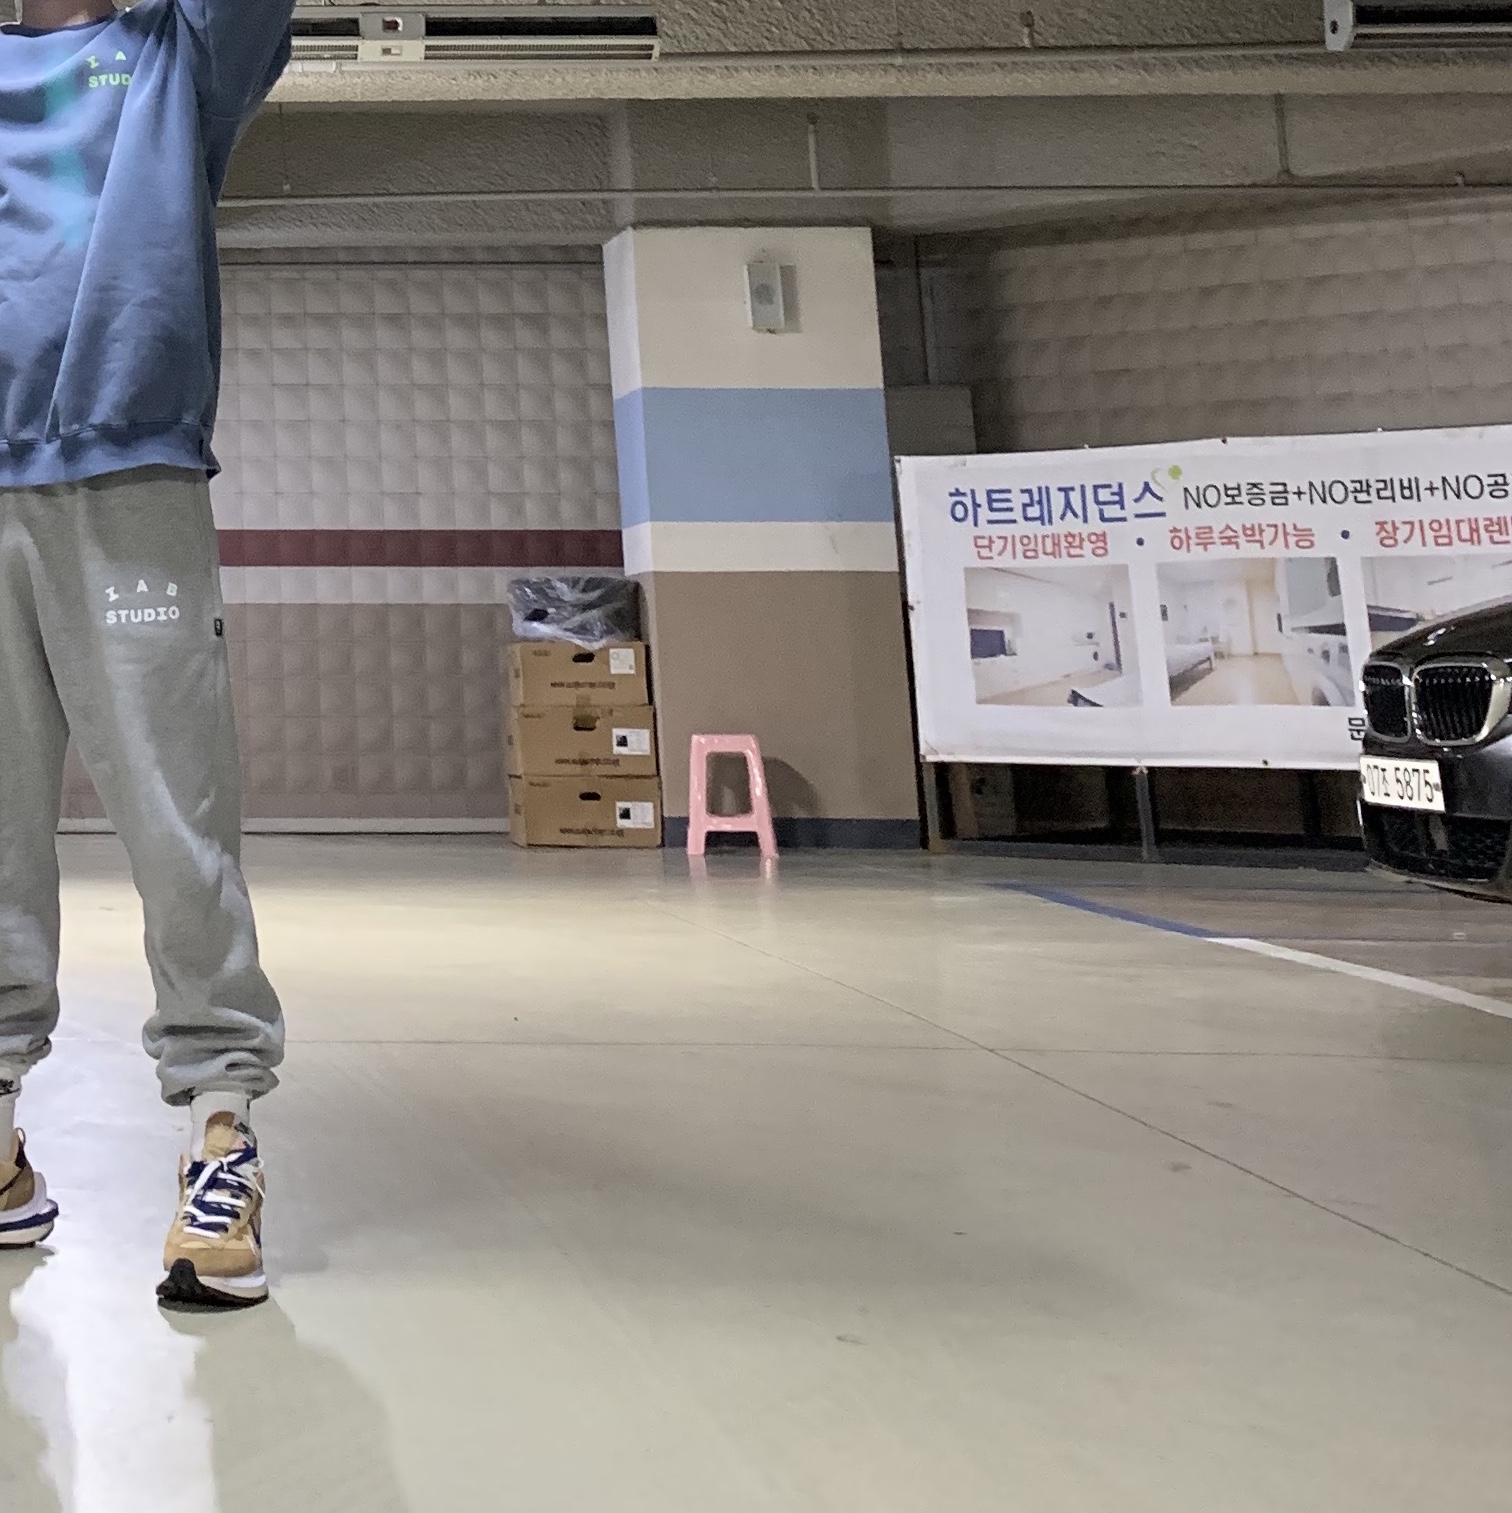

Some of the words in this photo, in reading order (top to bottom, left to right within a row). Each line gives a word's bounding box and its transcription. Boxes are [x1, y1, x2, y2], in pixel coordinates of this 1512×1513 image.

[948, 481, 1167, 527] 하트레지던스
[973, 530, 1110, 560] 단기임대환영
[1169, 522, 1315, 553] 하루숙박가능
[1375, 516, 1512, 548] 장기임대렌
[105, 606, 180, 624] STUDIO
[1394, 767, 1434, 803] 5875
